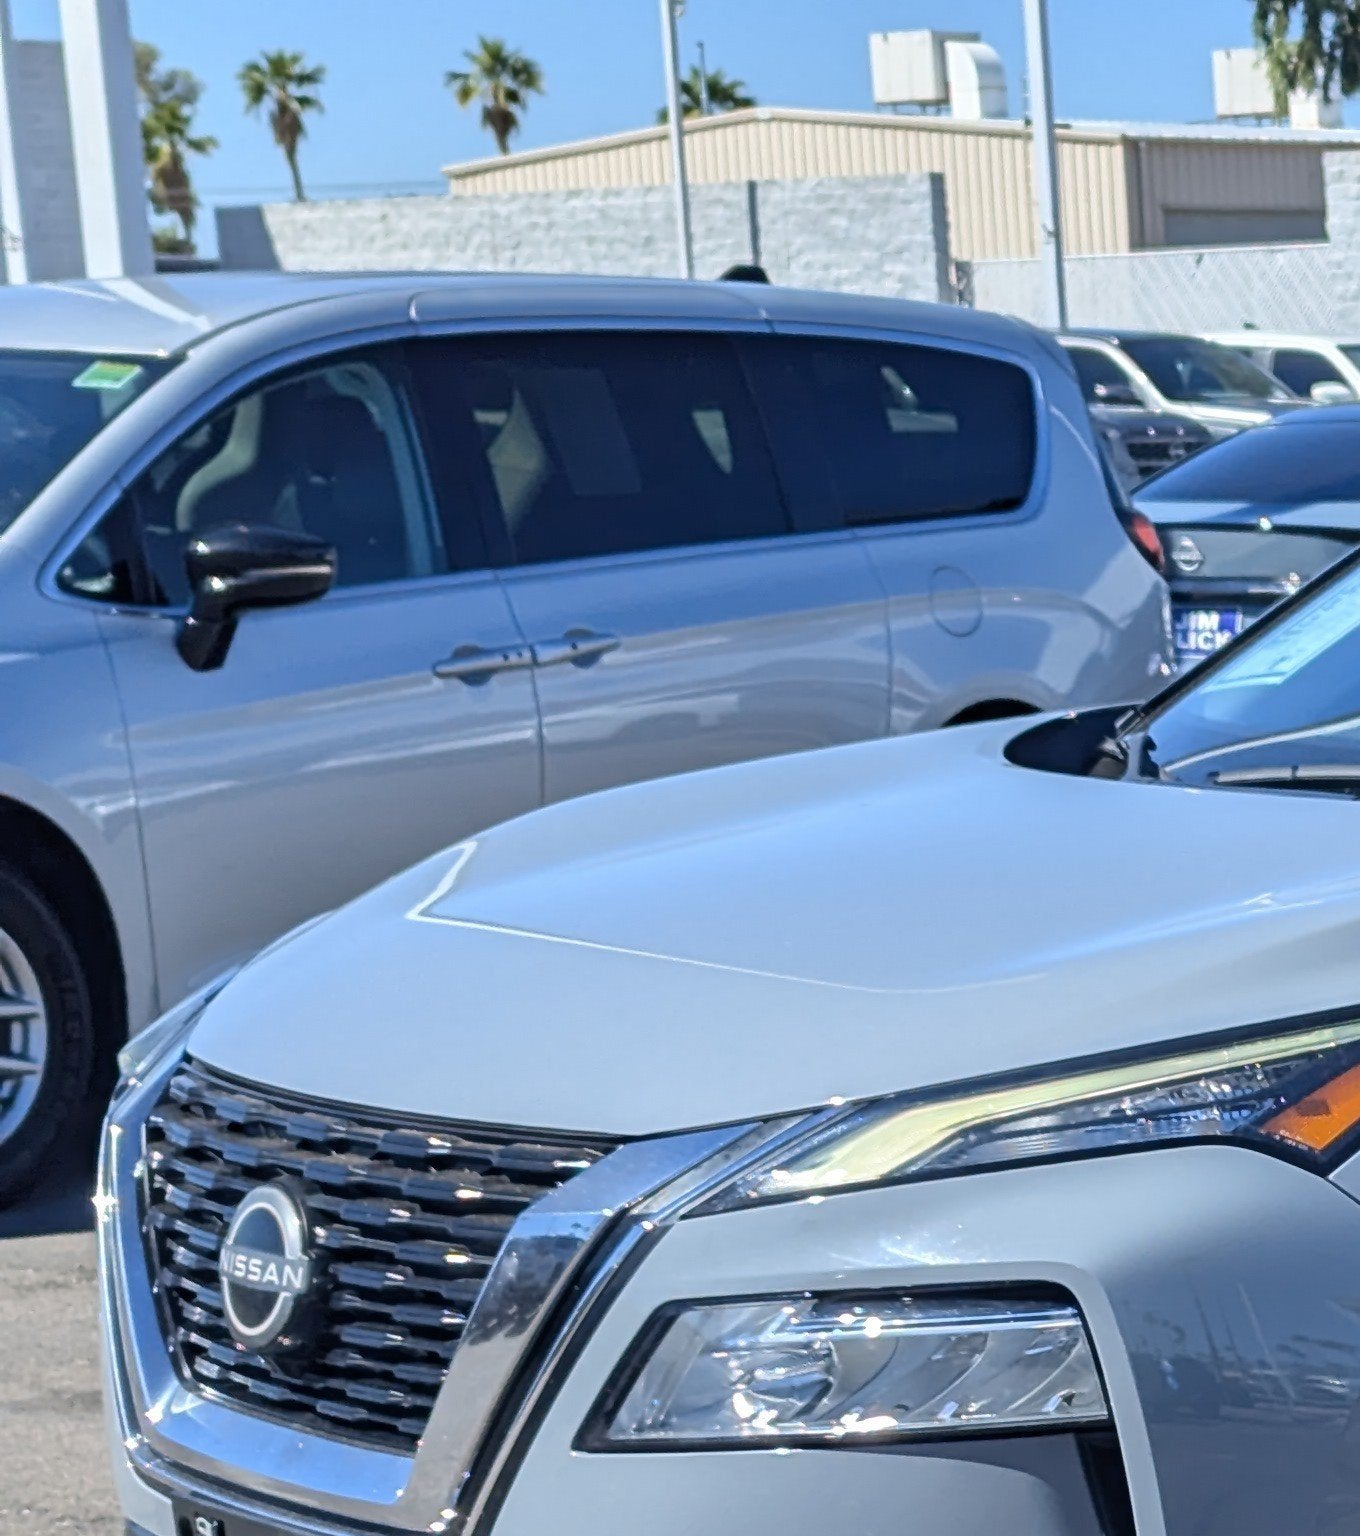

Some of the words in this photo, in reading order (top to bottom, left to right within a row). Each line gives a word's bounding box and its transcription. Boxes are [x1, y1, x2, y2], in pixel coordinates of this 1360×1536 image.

[1176, 610, 1220, 632] JIM
[1177, 631, 1231, 650] LICK
[220, 1249, 303, 1289] NISSAN
